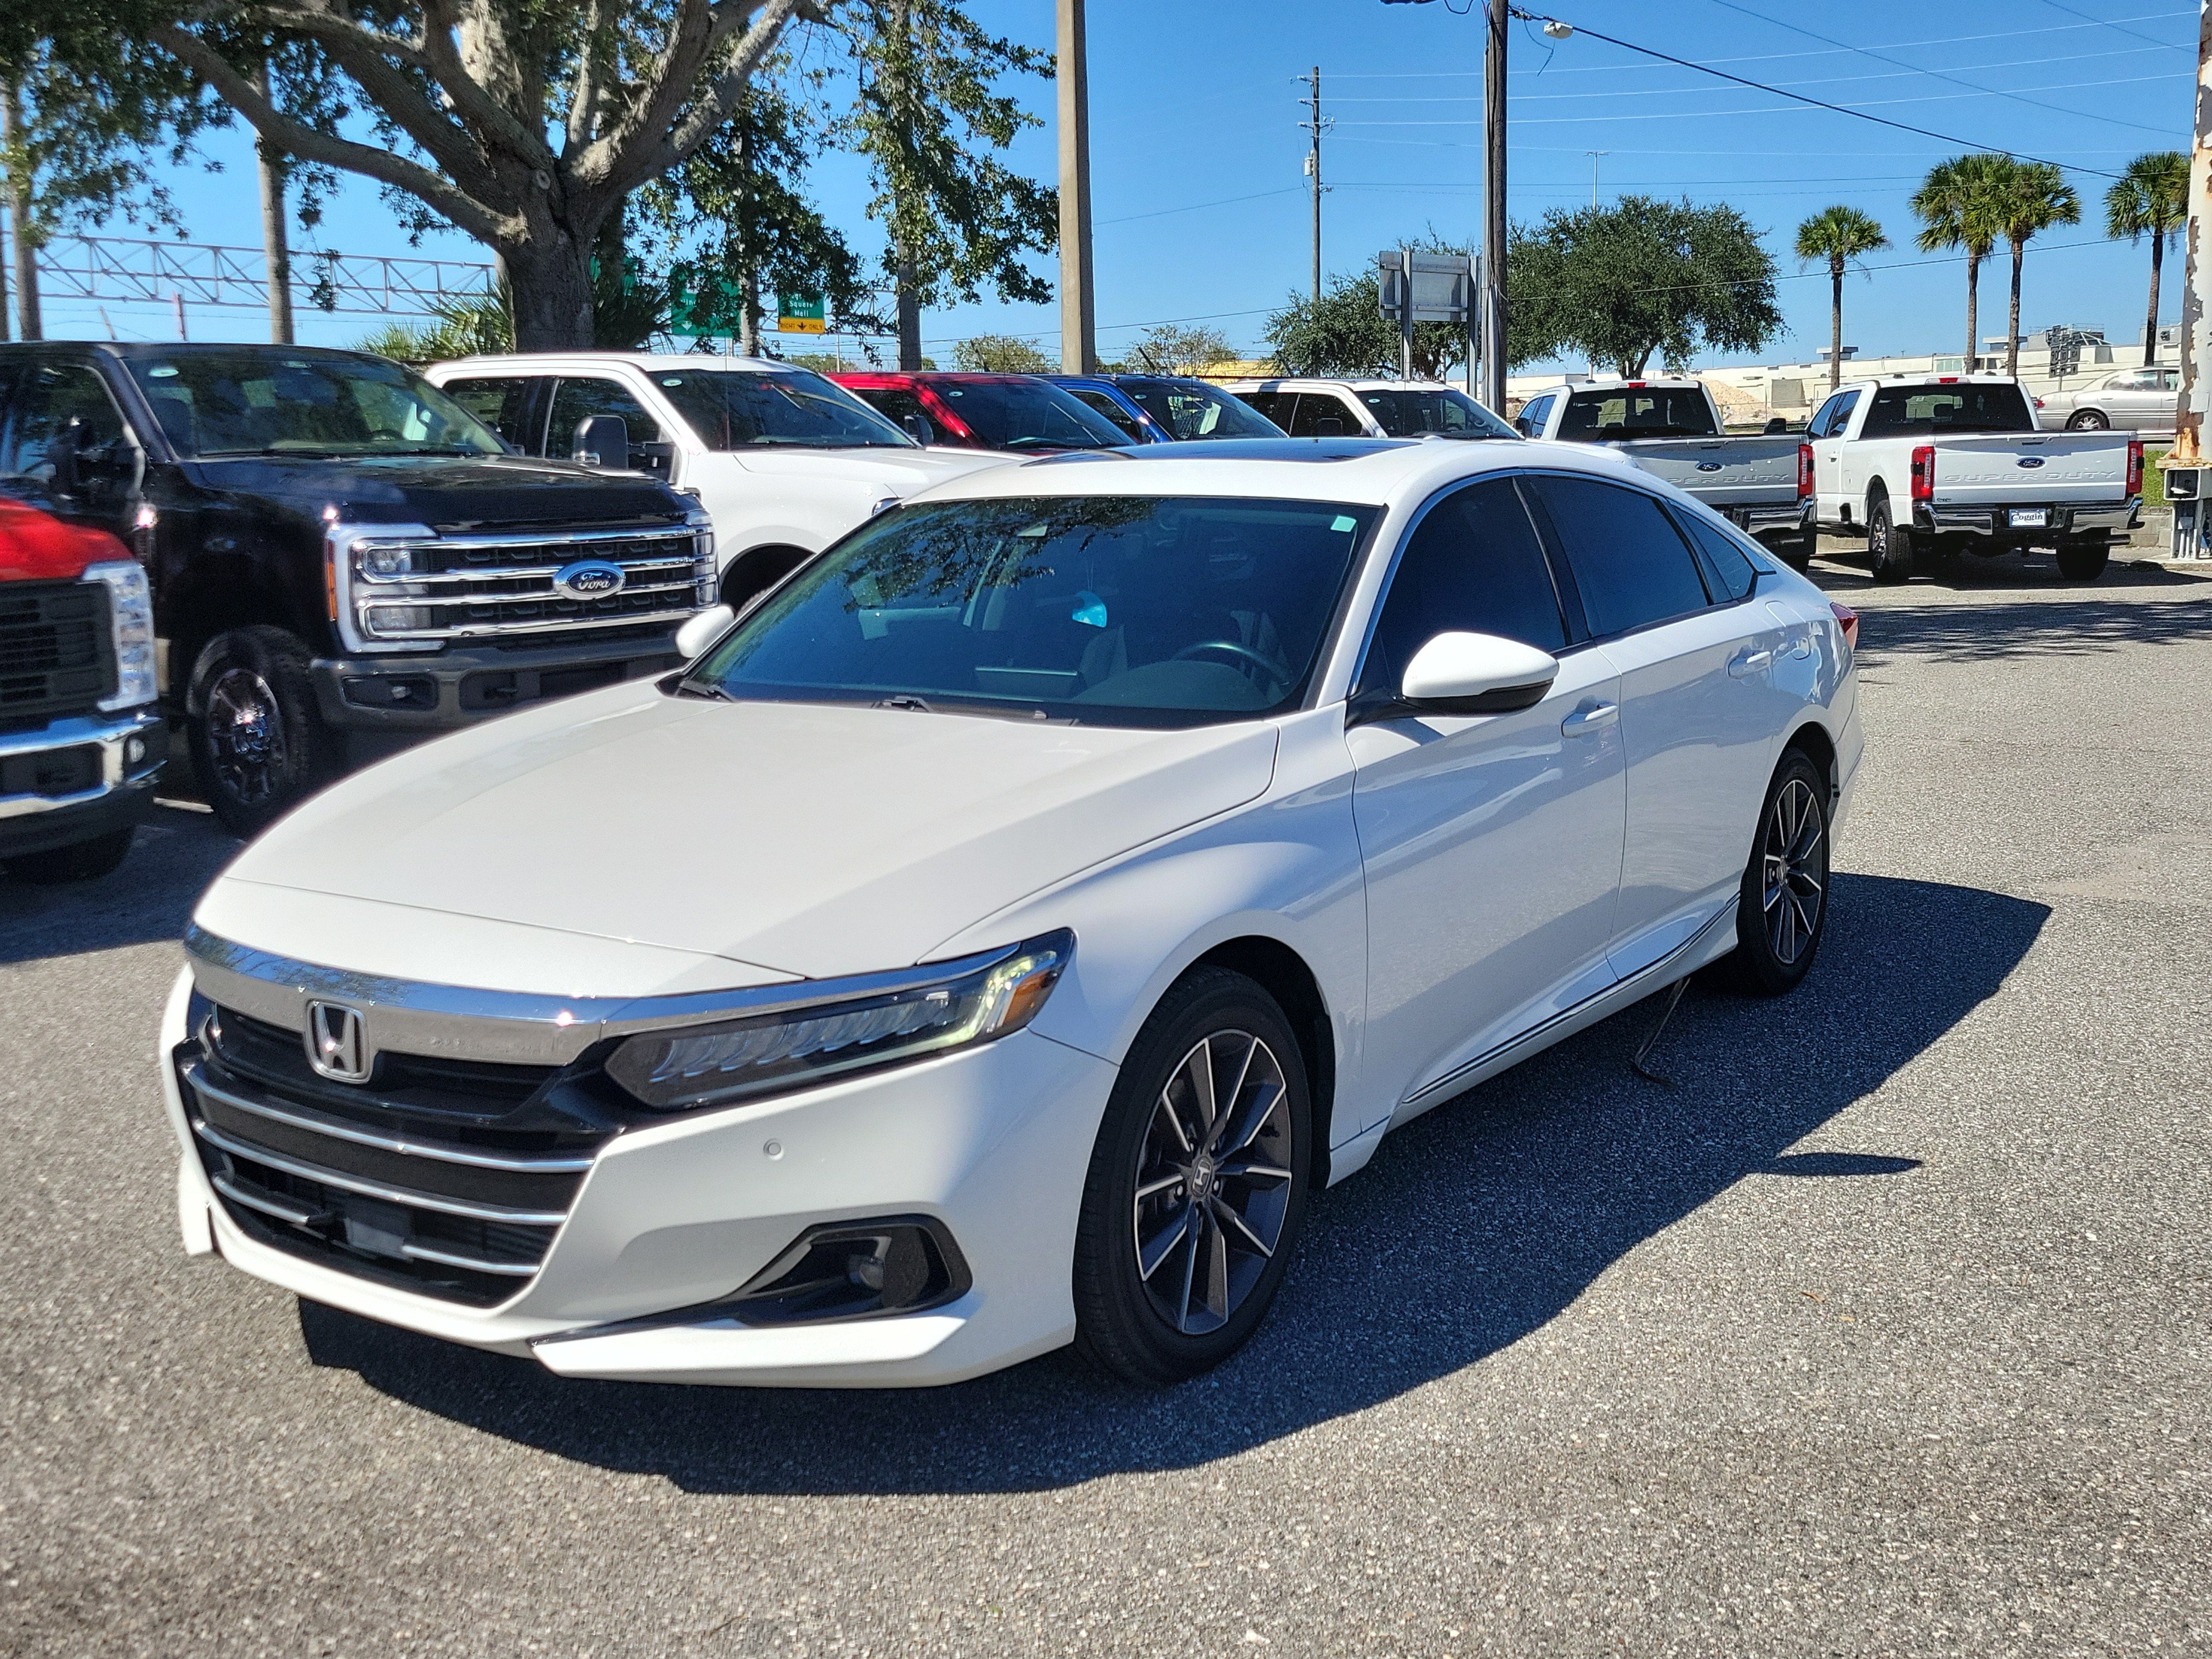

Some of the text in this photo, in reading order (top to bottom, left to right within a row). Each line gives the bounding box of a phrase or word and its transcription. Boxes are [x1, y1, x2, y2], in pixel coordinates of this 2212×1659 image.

[1723, 475, 1789, 483] DUTY
[1944, 471, 2116, 482] SUPER DUTY
[2011, 512, 2043, 522] Coggin
[578, 572, 612, 590] Ford
